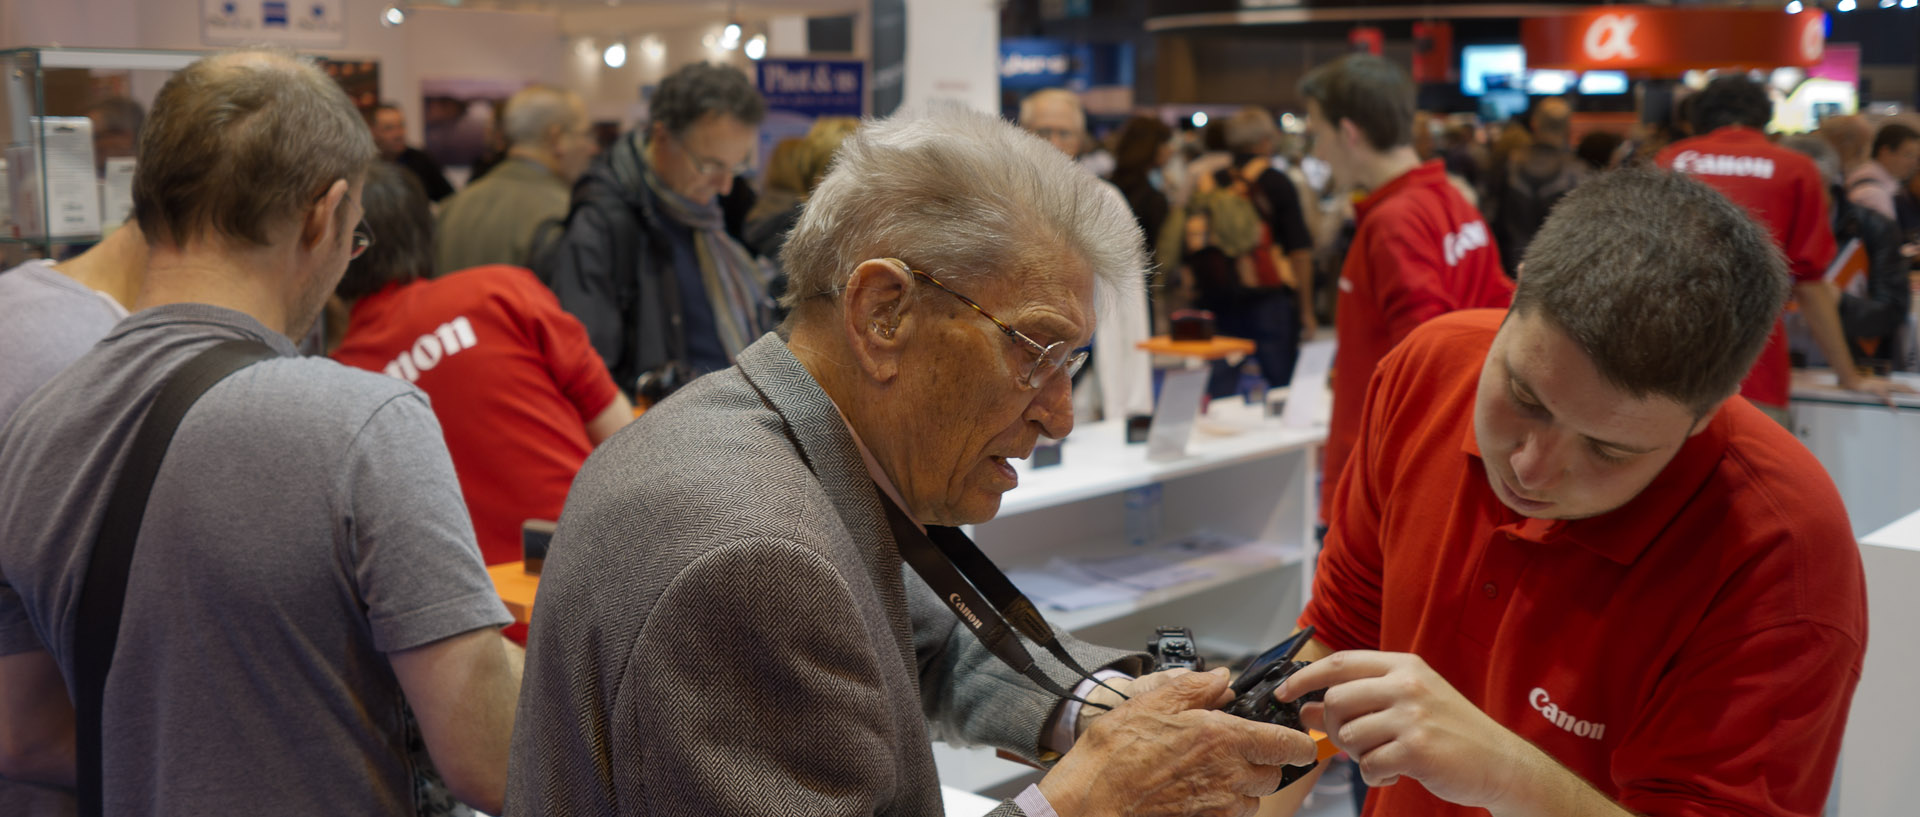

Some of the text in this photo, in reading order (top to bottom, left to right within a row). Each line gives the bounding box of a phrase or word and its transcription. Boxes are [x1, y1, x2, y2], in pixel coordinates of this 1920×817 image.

[1673, 150, 1773, 179] Canon
[384, 315, 477, 383] non
[949, 593, 982, 629] Canon
[1529, 687, 1605, 740] Canon
